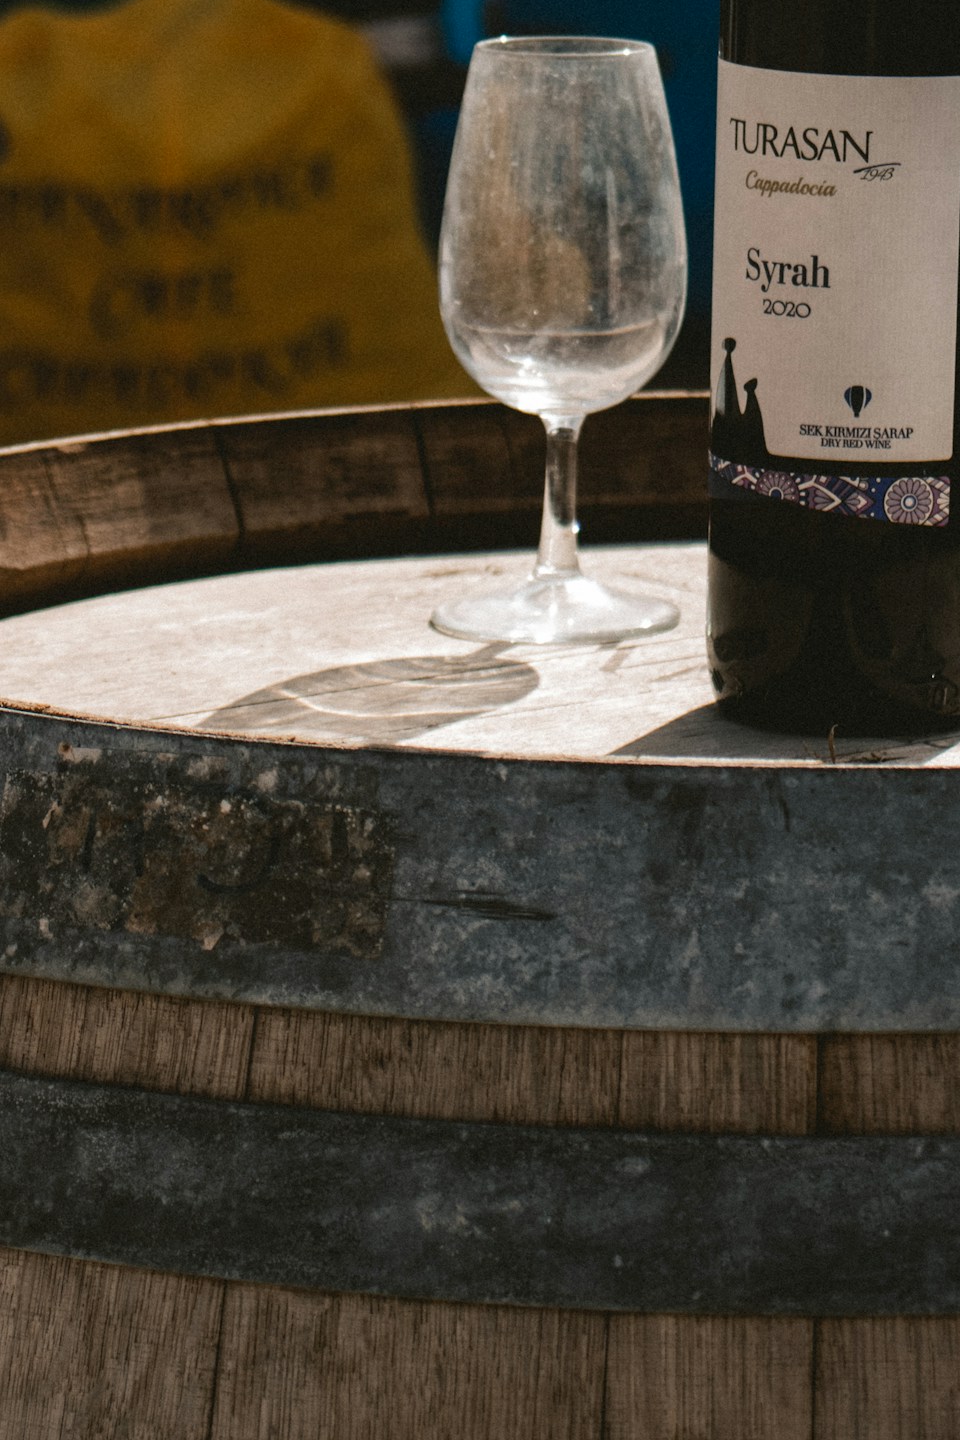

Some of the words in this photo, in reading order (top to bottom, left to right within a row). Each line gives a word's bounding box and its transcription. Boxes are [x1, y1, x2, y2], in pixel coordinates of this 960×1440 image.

[729, 117, 874, 163] TURASAN
[745, 169, 838, 198] Cappadocia
[859, 166, 896, 182] 1943
[745, 246, 831, 293] Syrah
[762, 298, 812, 319] 2020
[799, 424, 823, 437] SEK
[825, 426, 872, 439] KIRMIZI
[820, 438, 842, 448] DRY
[843, 439, 863, 449] RED
[864, 439, 892, 450] WINE
